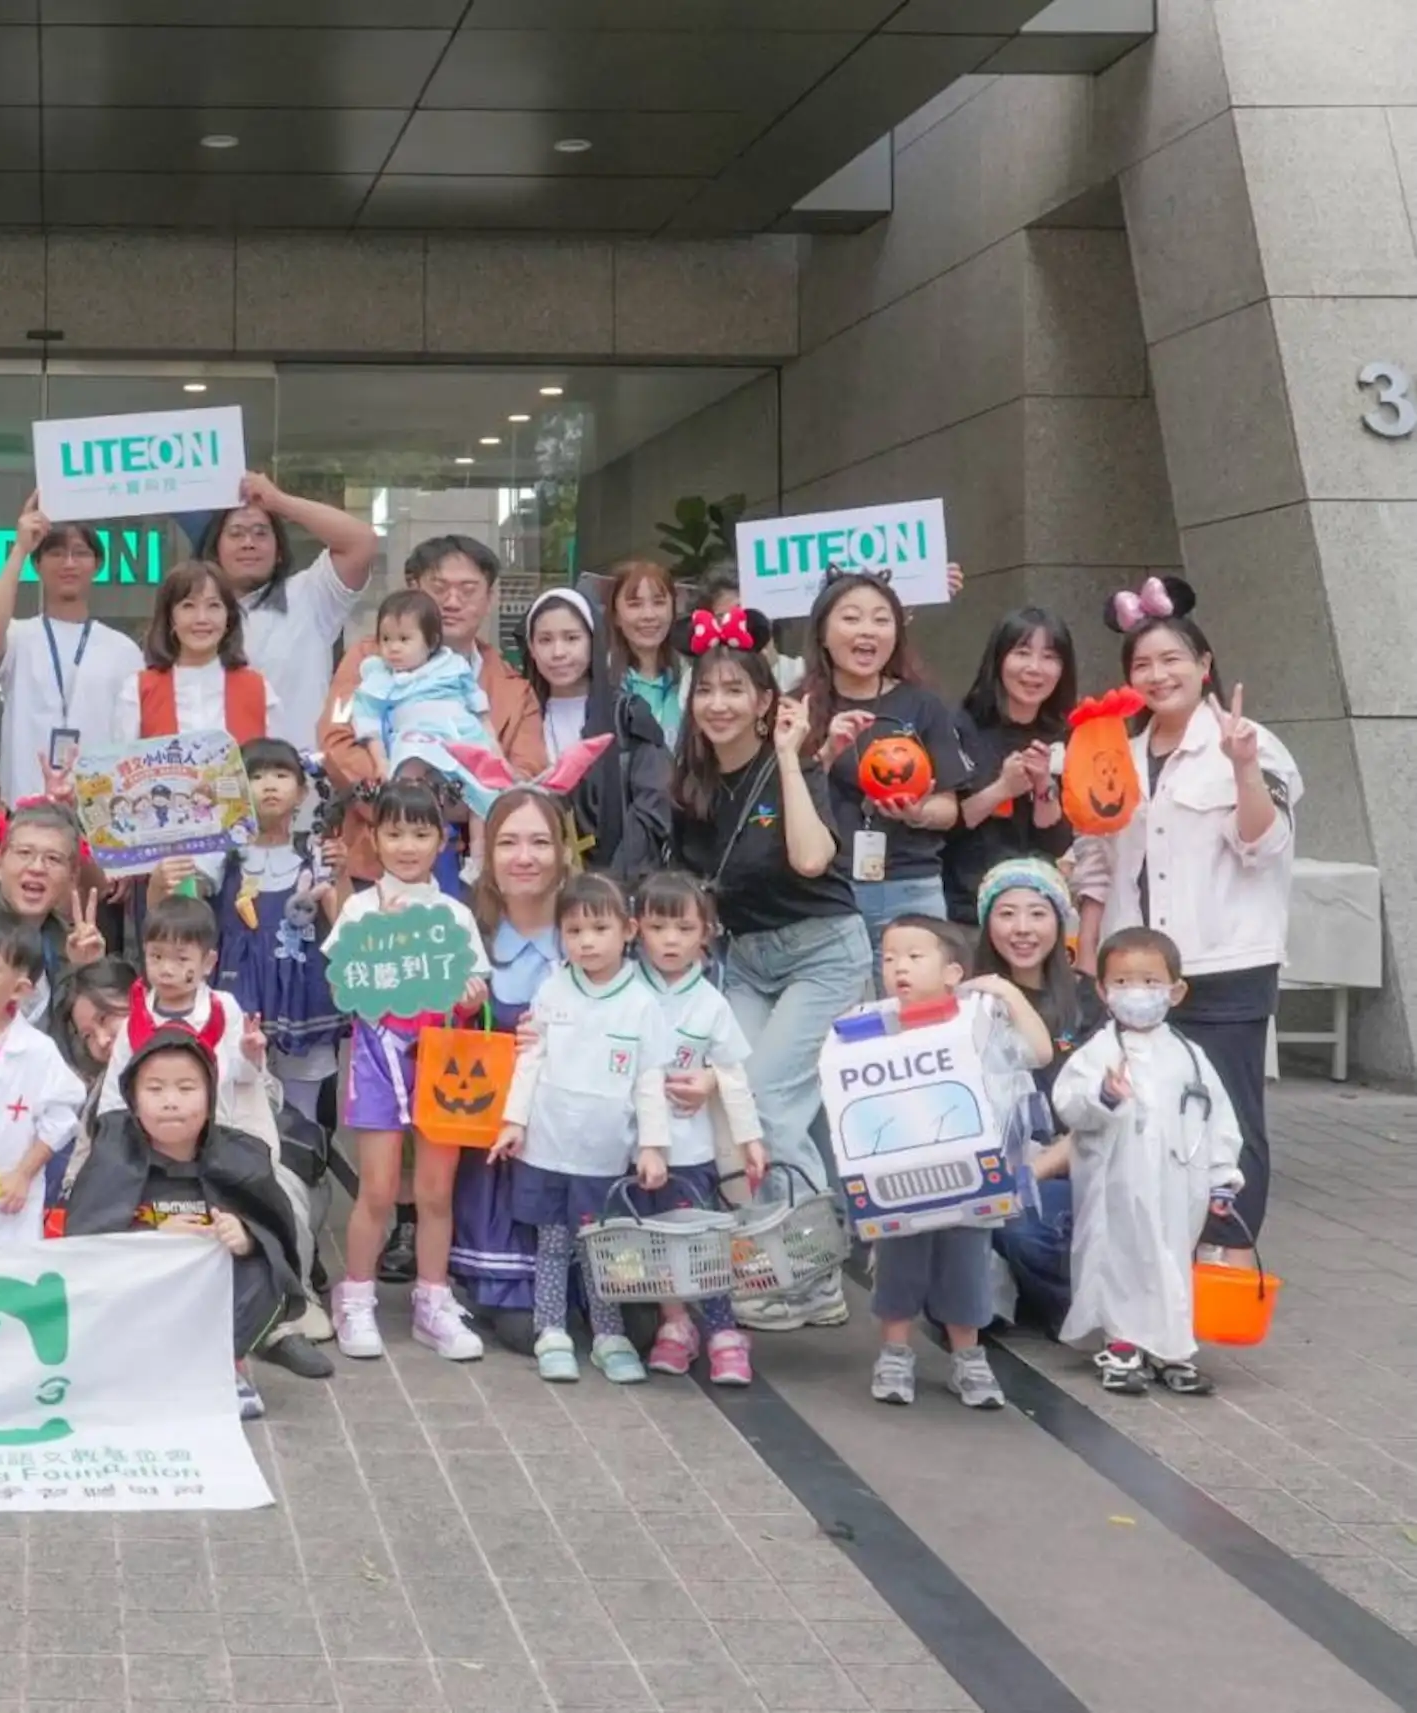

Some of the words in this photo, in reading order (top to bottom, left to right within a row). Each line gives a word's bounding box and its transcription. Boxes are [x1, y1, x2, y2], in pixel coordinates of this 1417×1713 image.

[1360, 362, 1417, 437] 3
[60, 430, 219, 478] LITEON
[753, 519, 928, 578] LITEON
[343, 952, 456, 990] 我聽到了
[839, 1047, 955, 1092] POLICE
